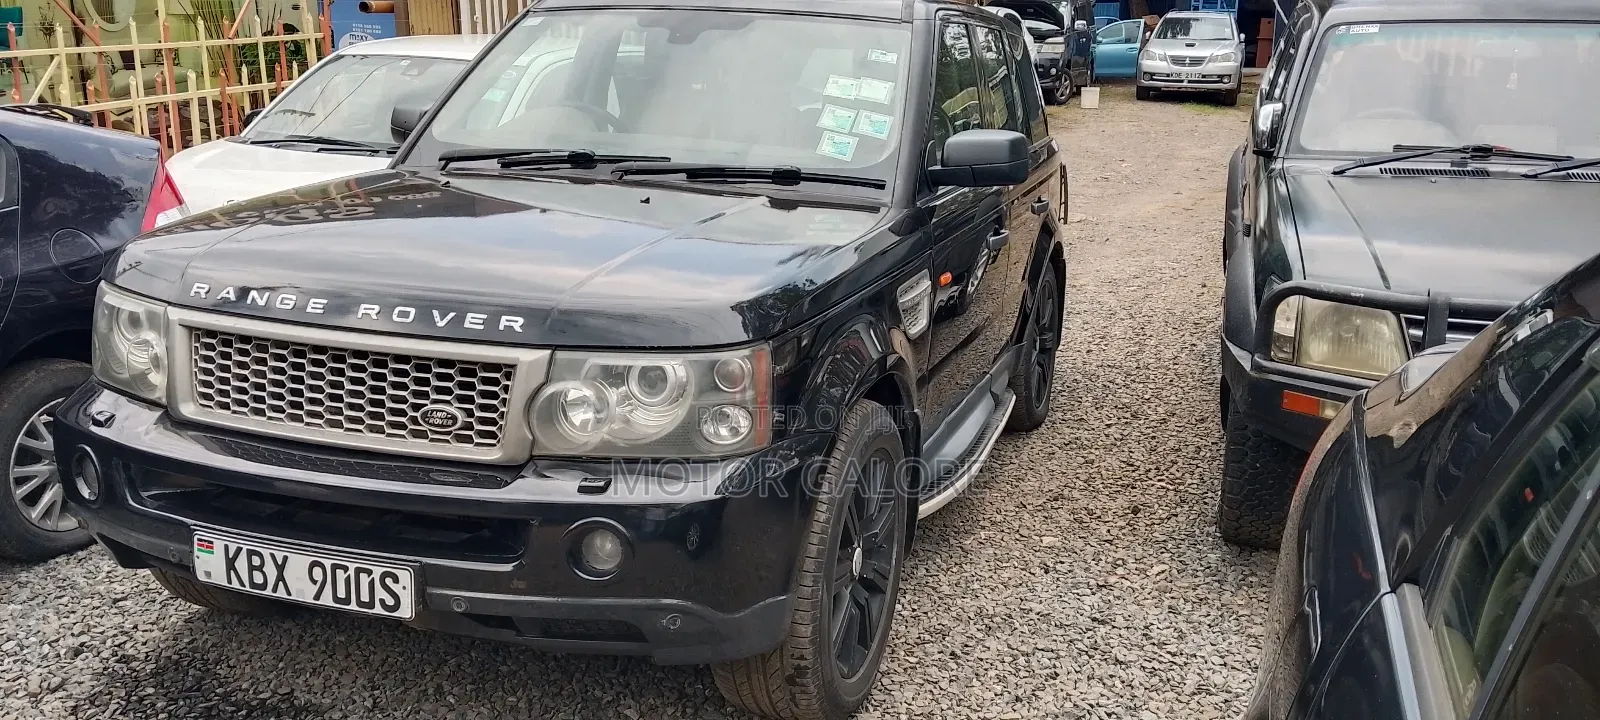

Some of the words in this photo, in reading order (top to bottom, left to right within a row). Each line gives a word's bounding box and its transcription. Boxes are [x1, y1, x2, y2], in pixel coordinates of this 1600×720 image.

[190, 282, 329, 314] RANGE
[356, 303, 525, 333] ROVER
[223, 543, 292, 597] KBX
[307, 559, 401, 613] 900S
